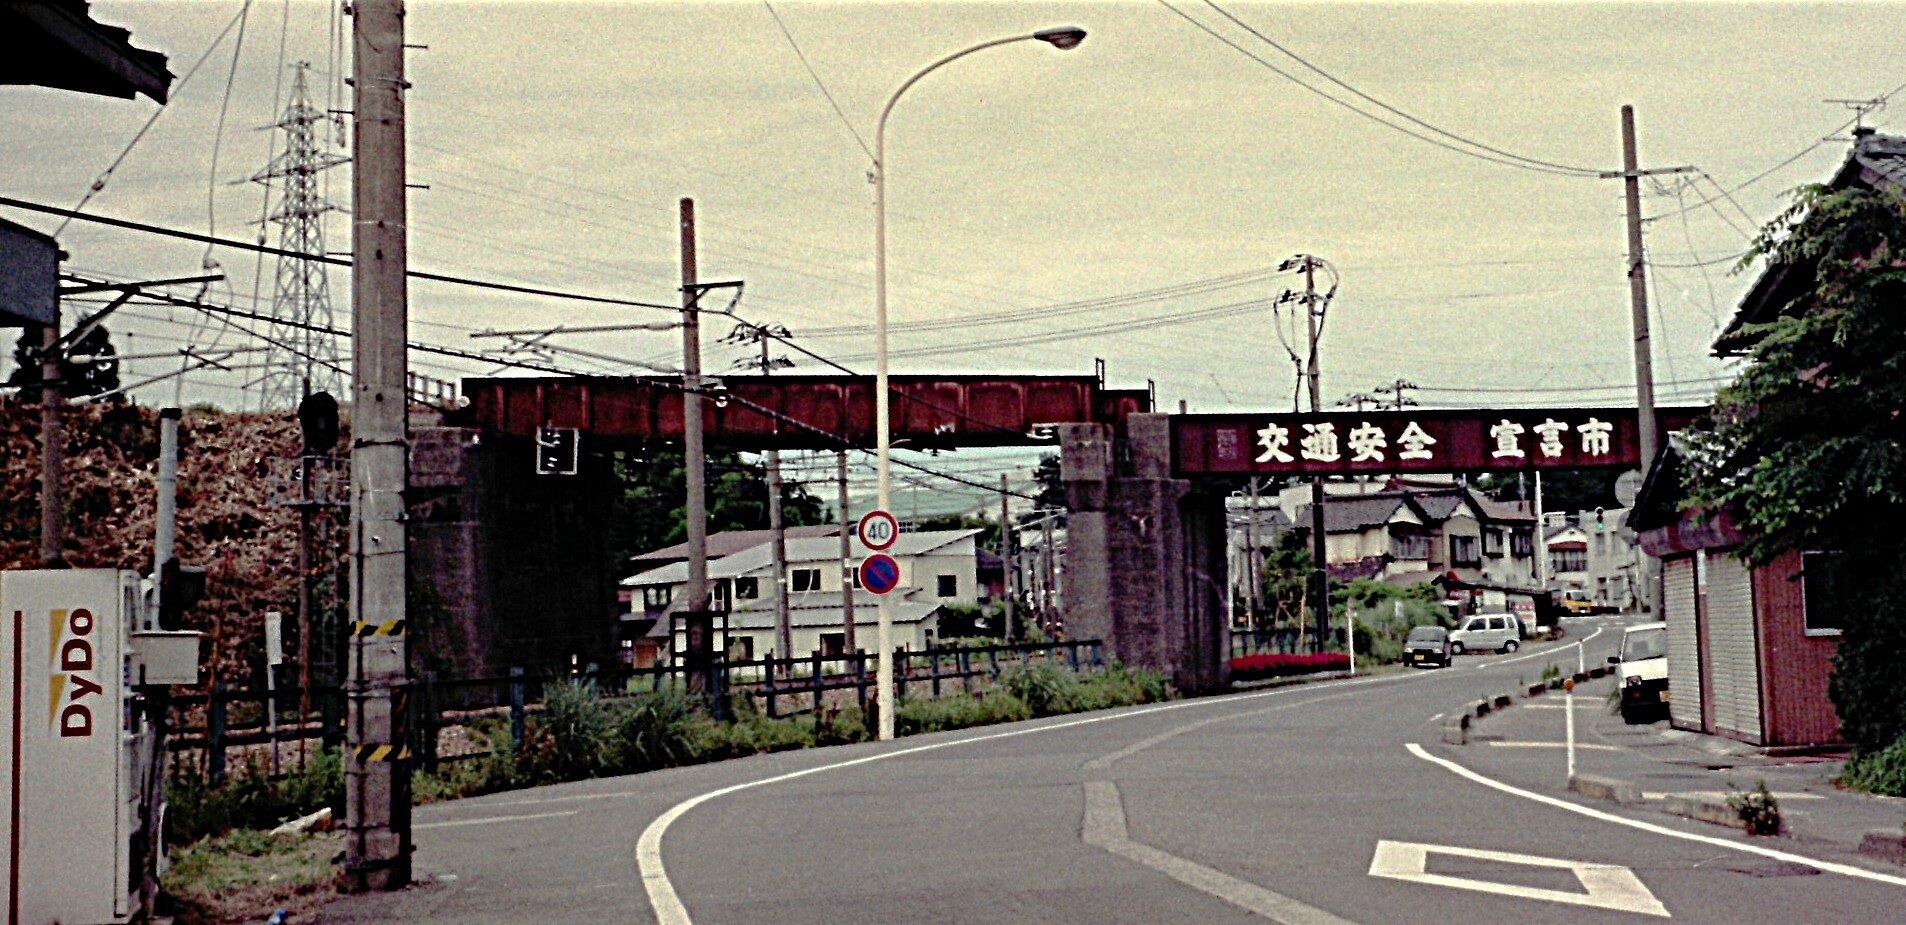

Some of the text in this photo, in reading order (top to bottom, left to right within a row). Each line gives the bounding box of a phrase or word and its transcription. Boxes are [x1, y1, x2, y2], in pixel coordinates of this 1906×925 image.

[1255, 421, 1437, 463] 交通安全
[1490, 417, 1613, 458] 宣言市
[868, 521, 890, 540] 40
[61, 608, 103, 737] DyDo
